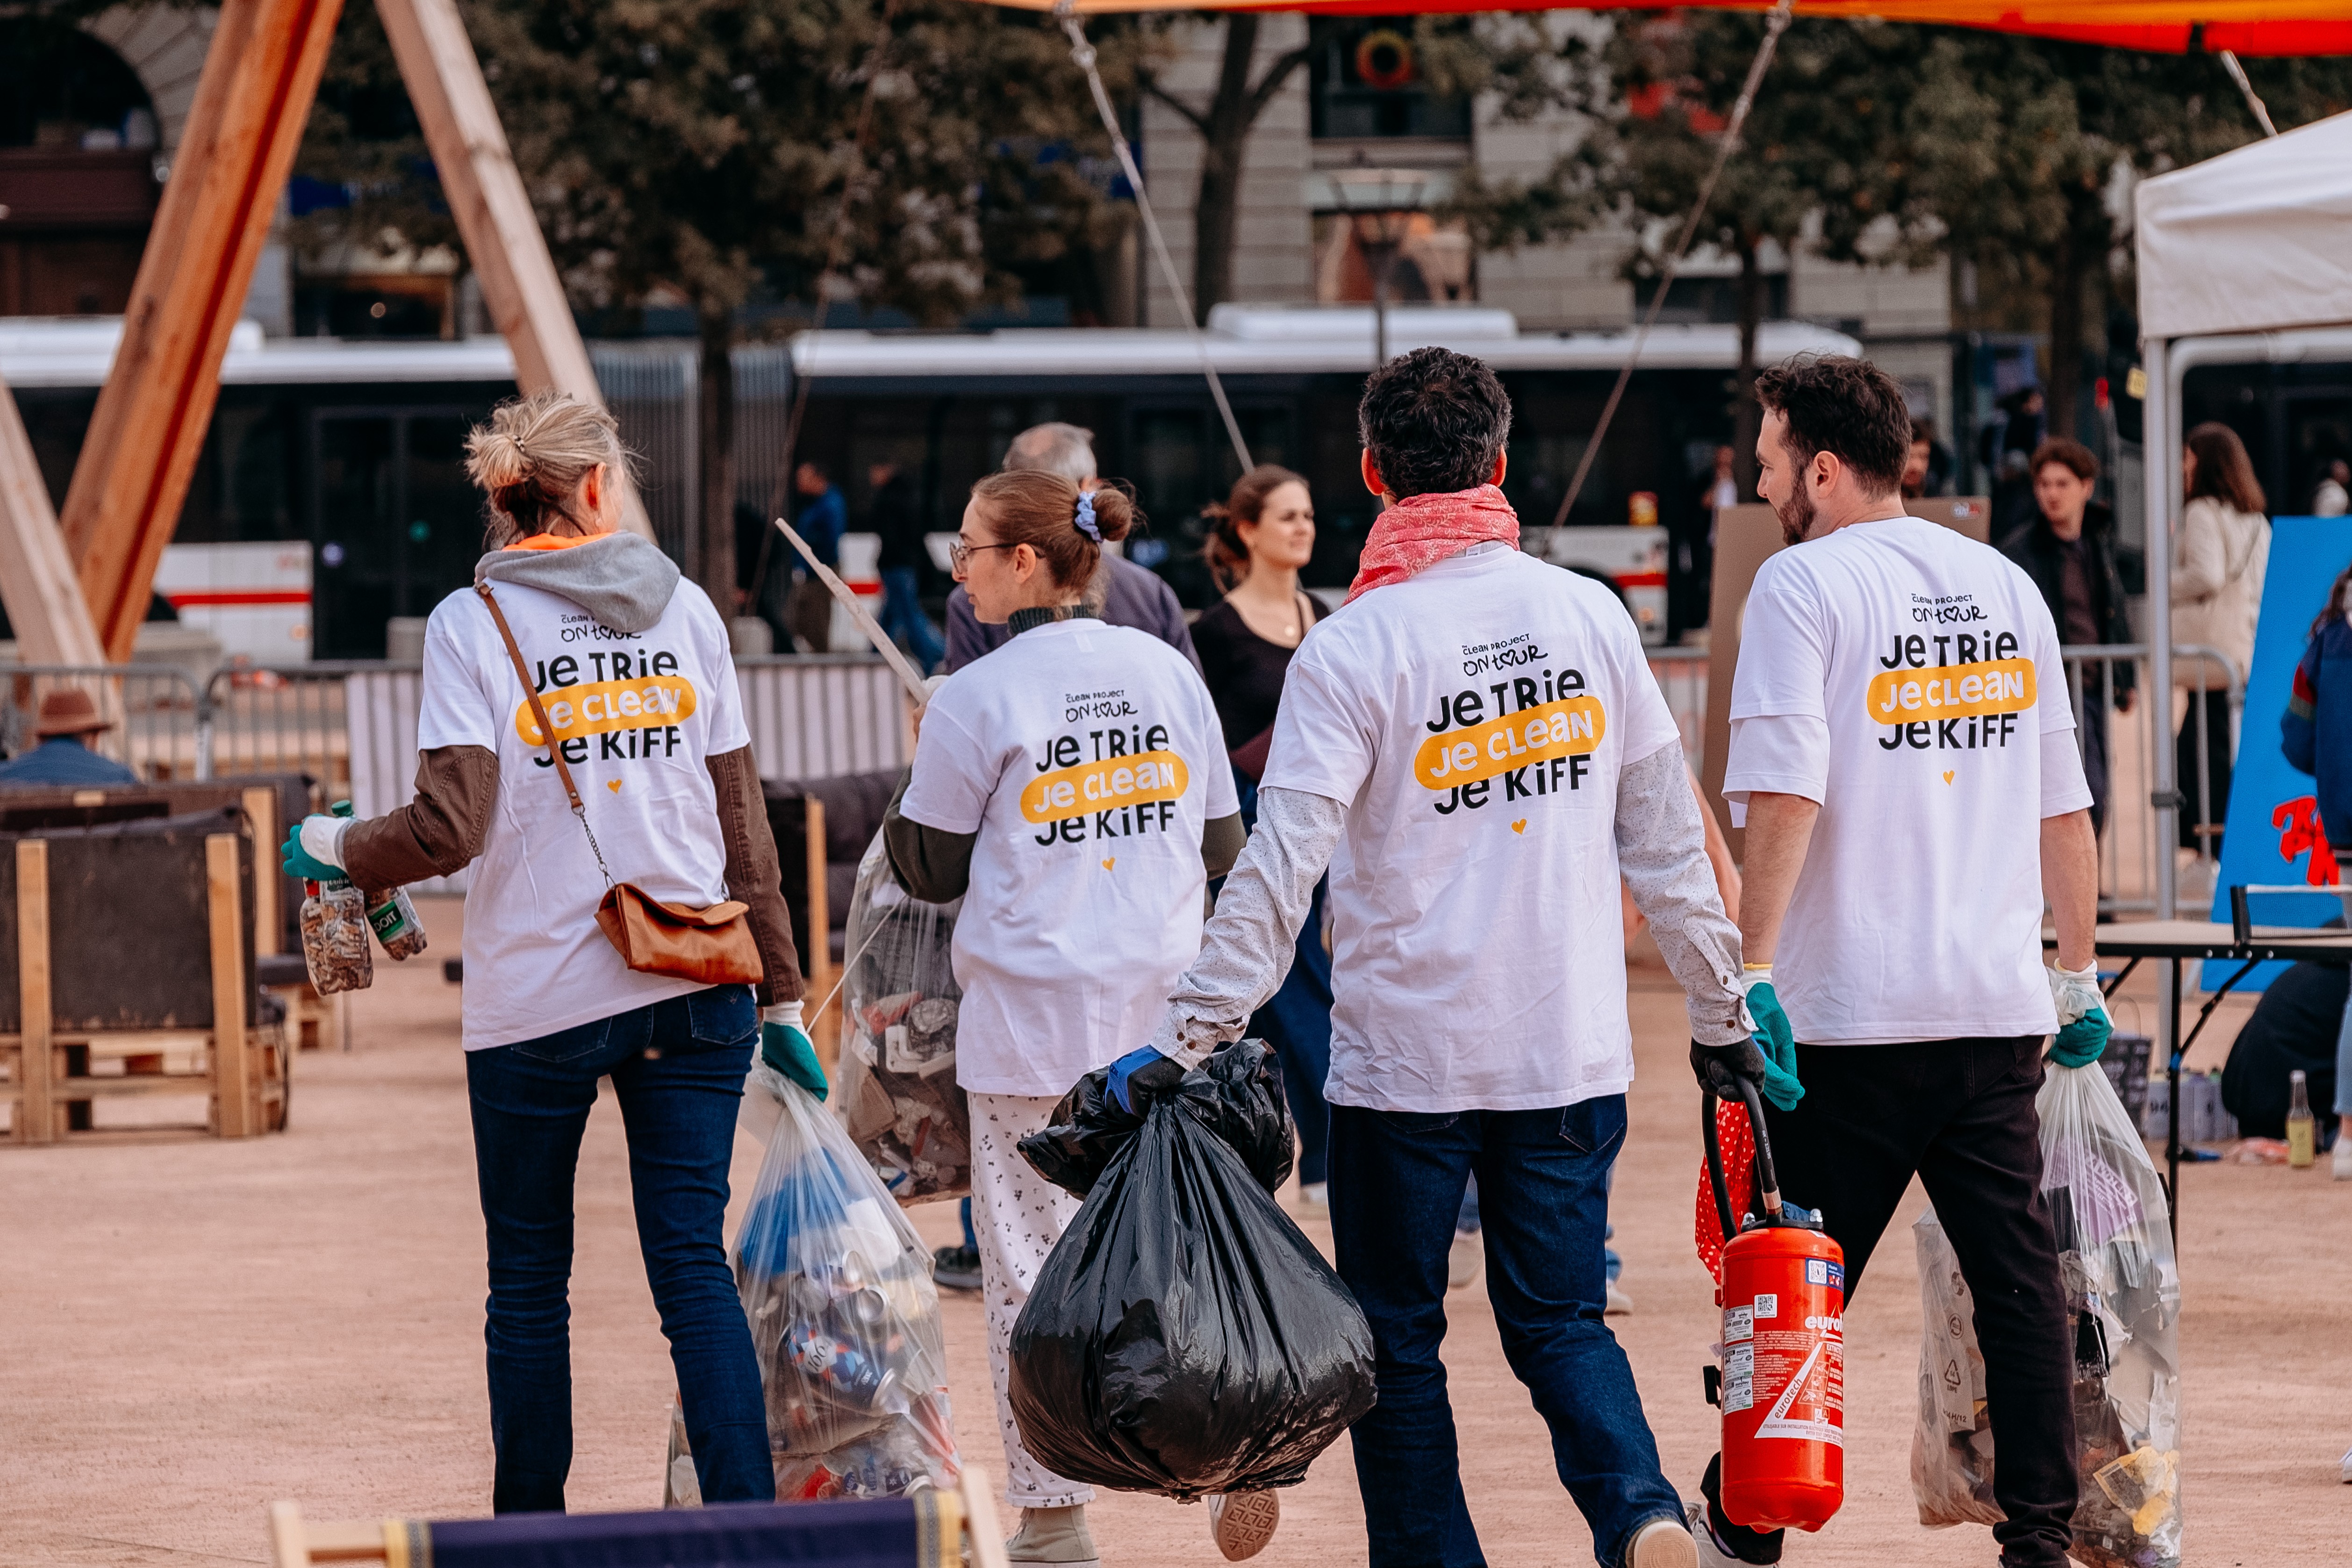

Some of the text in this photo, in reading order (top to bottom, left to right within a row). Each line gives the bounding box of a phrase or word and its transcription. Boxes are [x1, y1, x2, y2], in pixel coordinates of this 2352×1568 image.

[1912, 607, 1933, 622] ON
[561, 624, 588, 642] ON
[1463, 655, 1489, 676] ON
[1880, 634, 1926, 669] Je
[534, 655, 579, 693] Je
[1066, 702, 1090, 723] ON
[1427, 690, 1484, 733] Je
[1880, 681, 1922, 713] Je
[1878, 720, 1932, 751] Je
[1036, 735, 1081, 772] Je
[1429, 741, 1478, 778] Je
[1033, 781, 1076, 813] Je
[1434, 778, 1490, 815] Je
[1034, 815, 1086, 846] Je
[1775, 1377, 1802, 1419] eurotech
